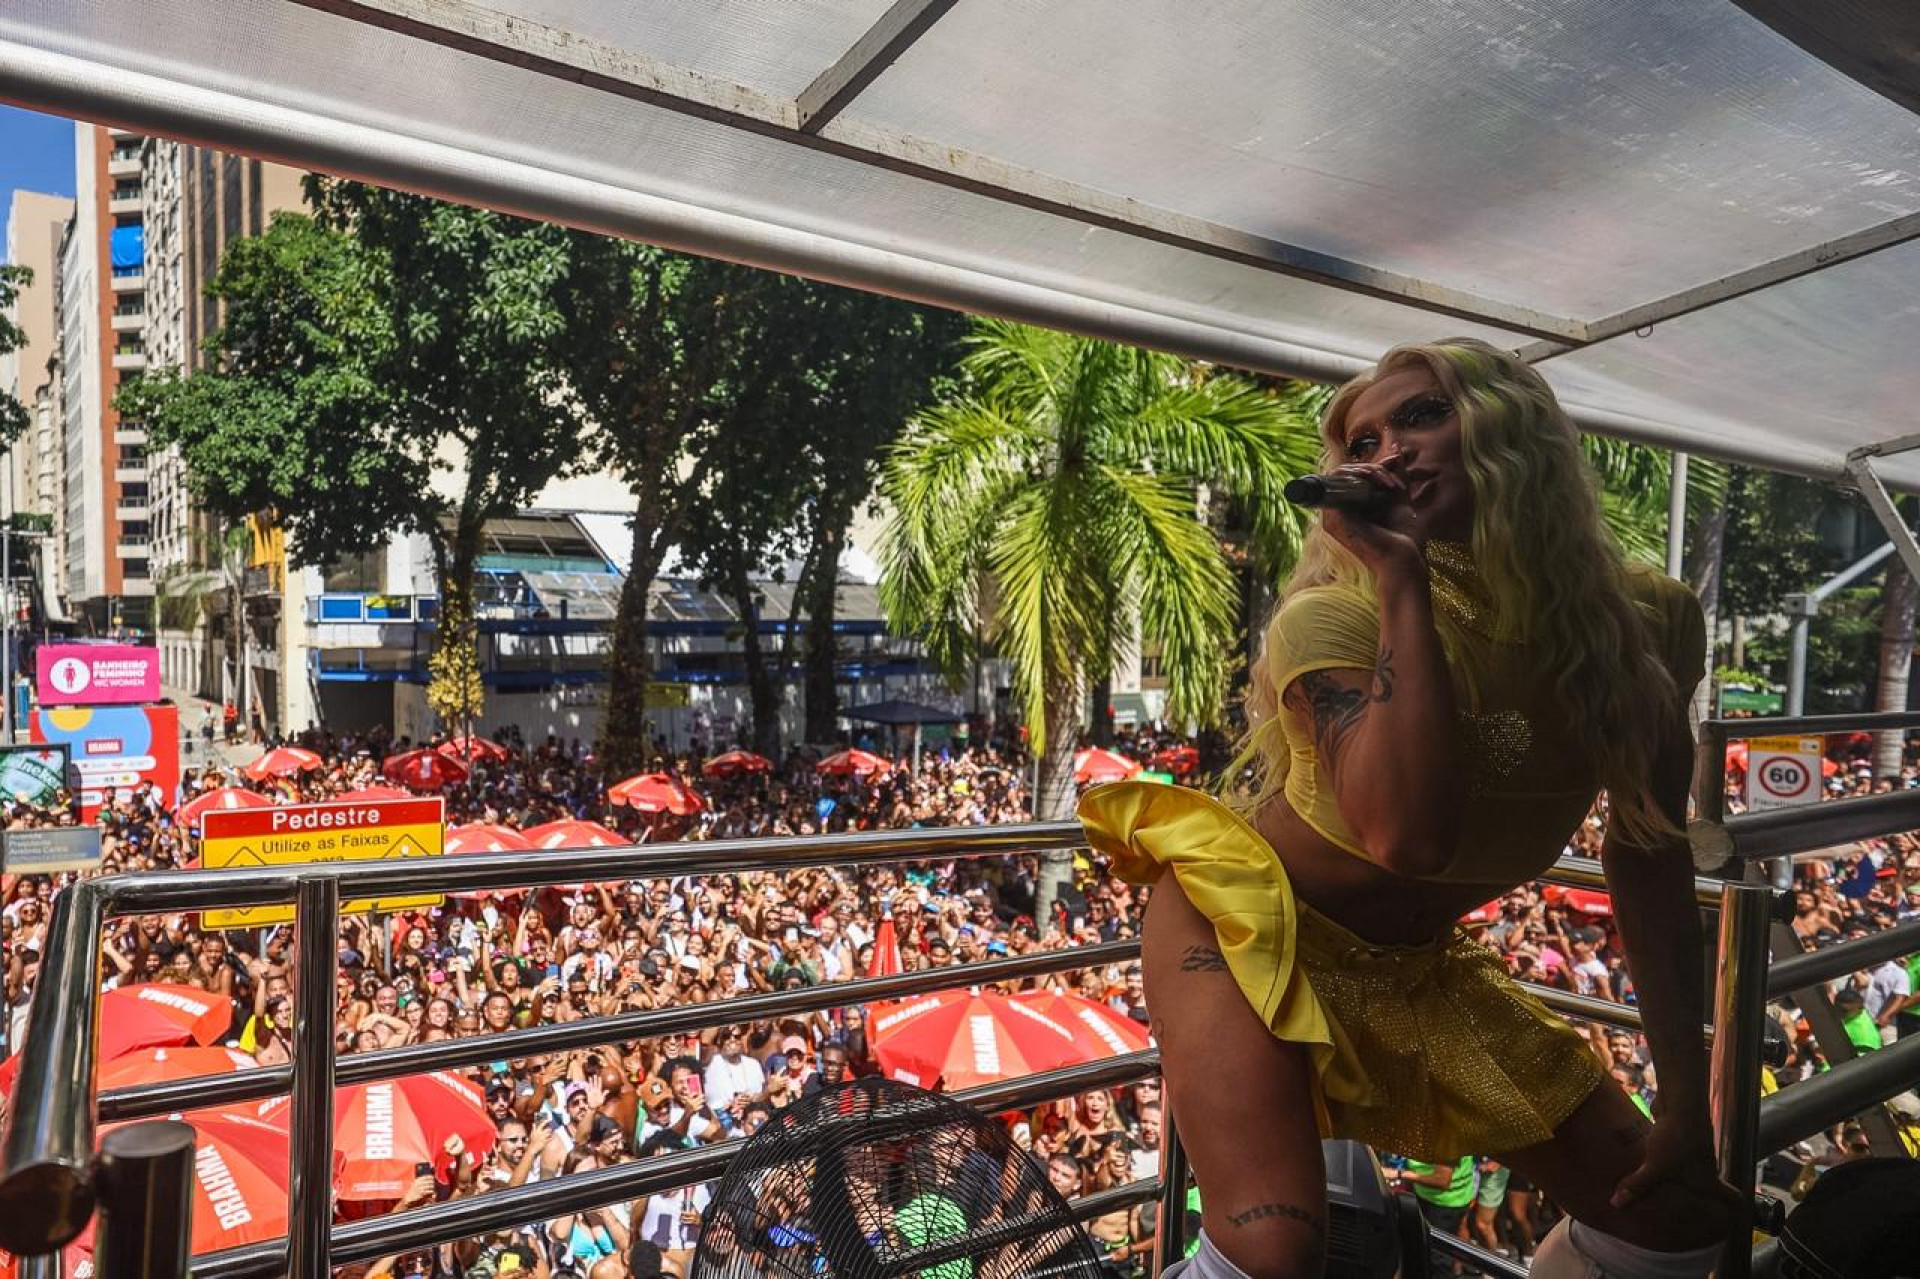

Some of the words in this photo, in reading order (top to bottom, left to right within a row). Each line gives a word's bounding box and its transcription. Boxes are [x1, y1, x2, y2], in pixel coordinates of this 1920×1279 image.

[1769, 767, 1798, 785] 60
[272, 808, 380, 831] Pedestre
[262, 840, 311, 854] Utilize
[317, 840, 336, 850] as
[341, 833, 390, 848] Faixas
[365, 1083, 393, 1159] BRAHMA
[195, 1144, 252, 1231] BRAHMA
